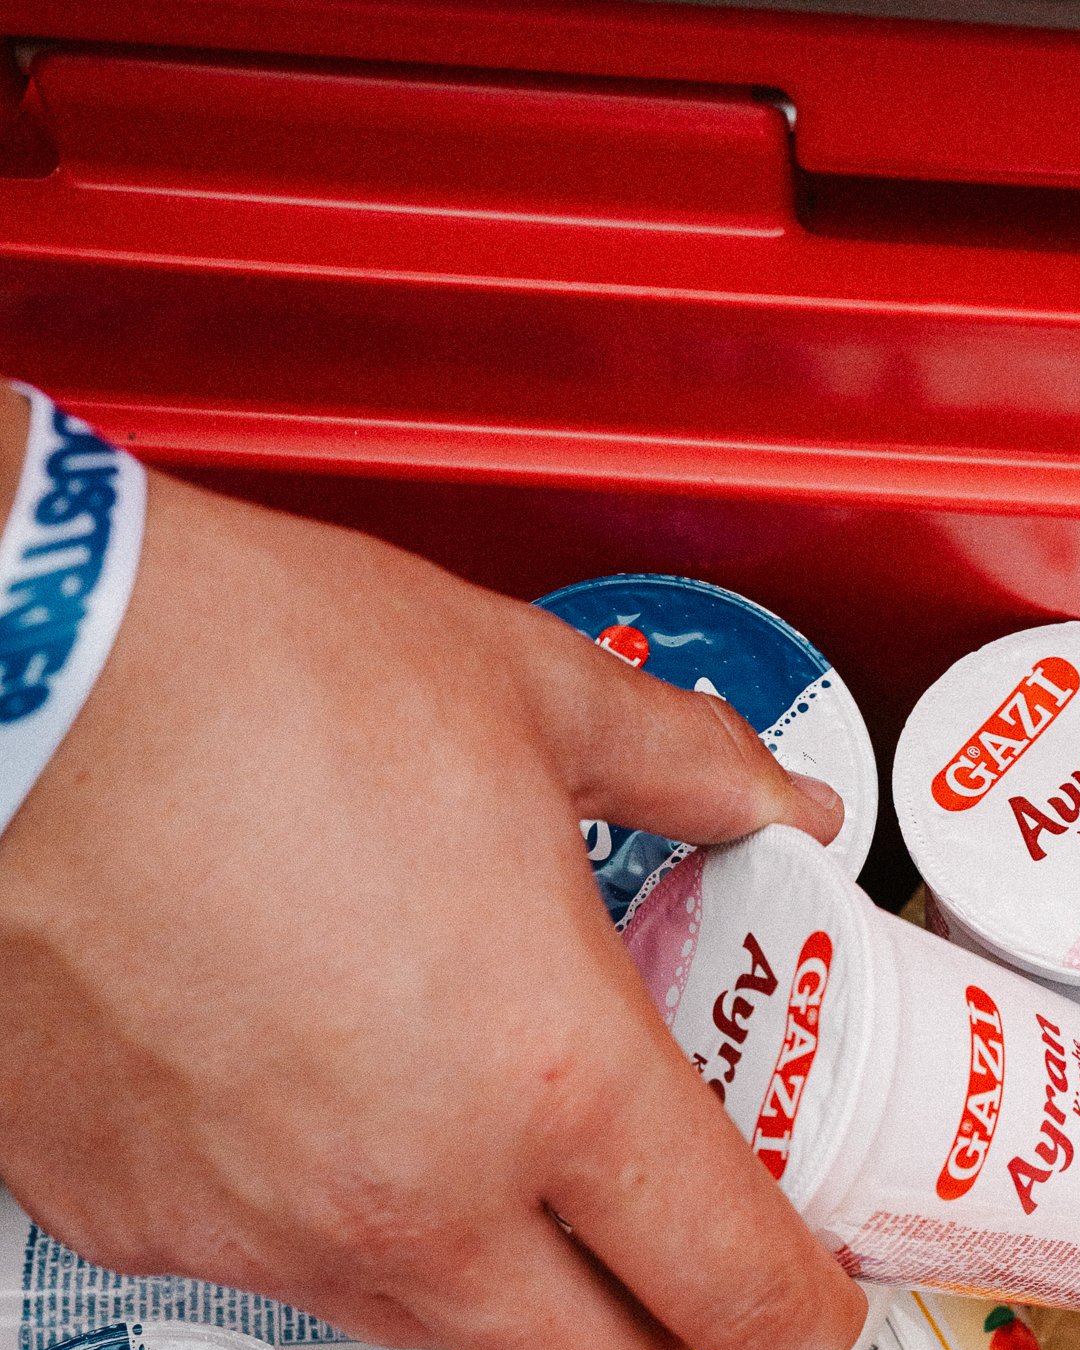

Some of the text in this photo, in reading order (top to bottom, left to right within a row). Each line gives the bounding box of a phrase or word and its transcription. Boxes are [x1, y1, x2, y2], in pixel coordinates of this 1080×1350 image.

[944, 666, 1074, 798] GAZI
[946, 1000, 1002, 1184] GAZI
[1006, 1013, 1075, 1215] Ayran
